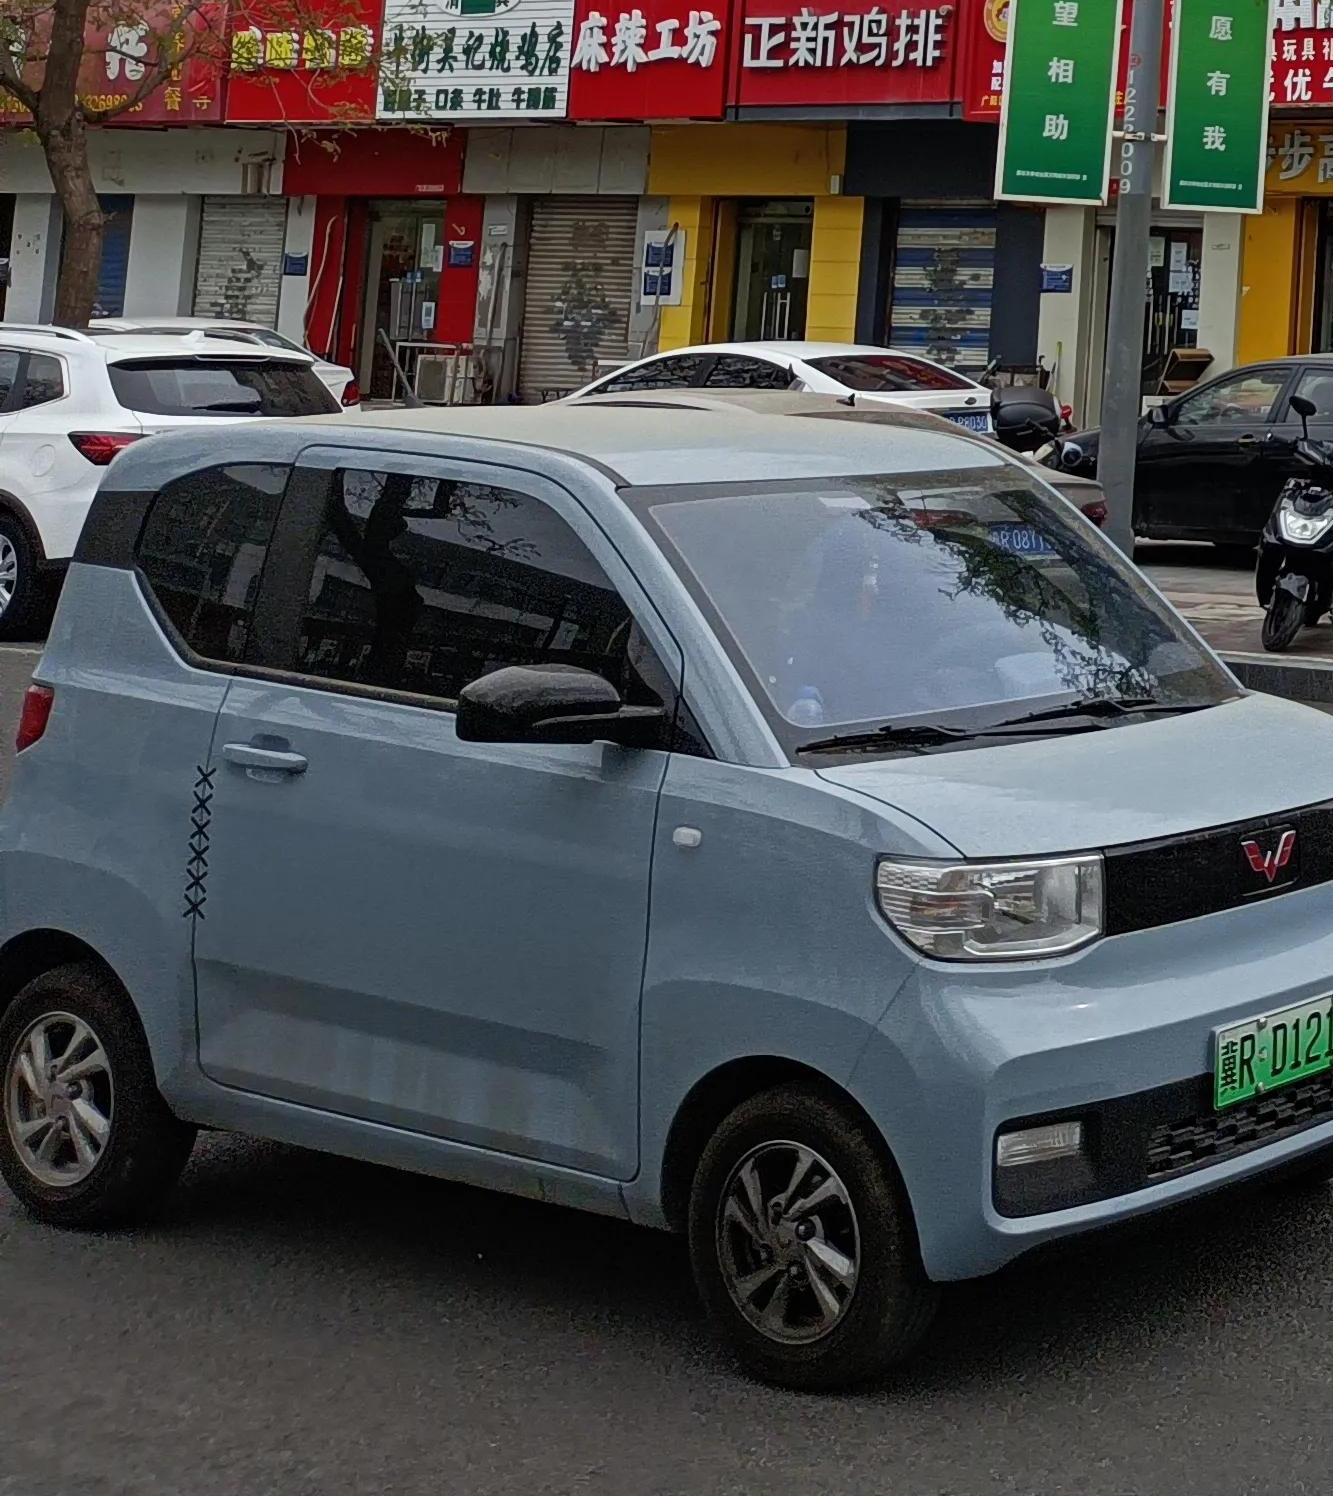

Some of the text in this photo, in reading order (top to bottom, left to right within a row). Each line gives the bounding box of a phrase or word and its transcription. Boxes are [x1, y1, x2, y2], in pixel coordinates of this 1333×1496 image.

[571, 9, 721, 72] 麻辣工坊
[743, 7, 943, 67] 正新鸡排
